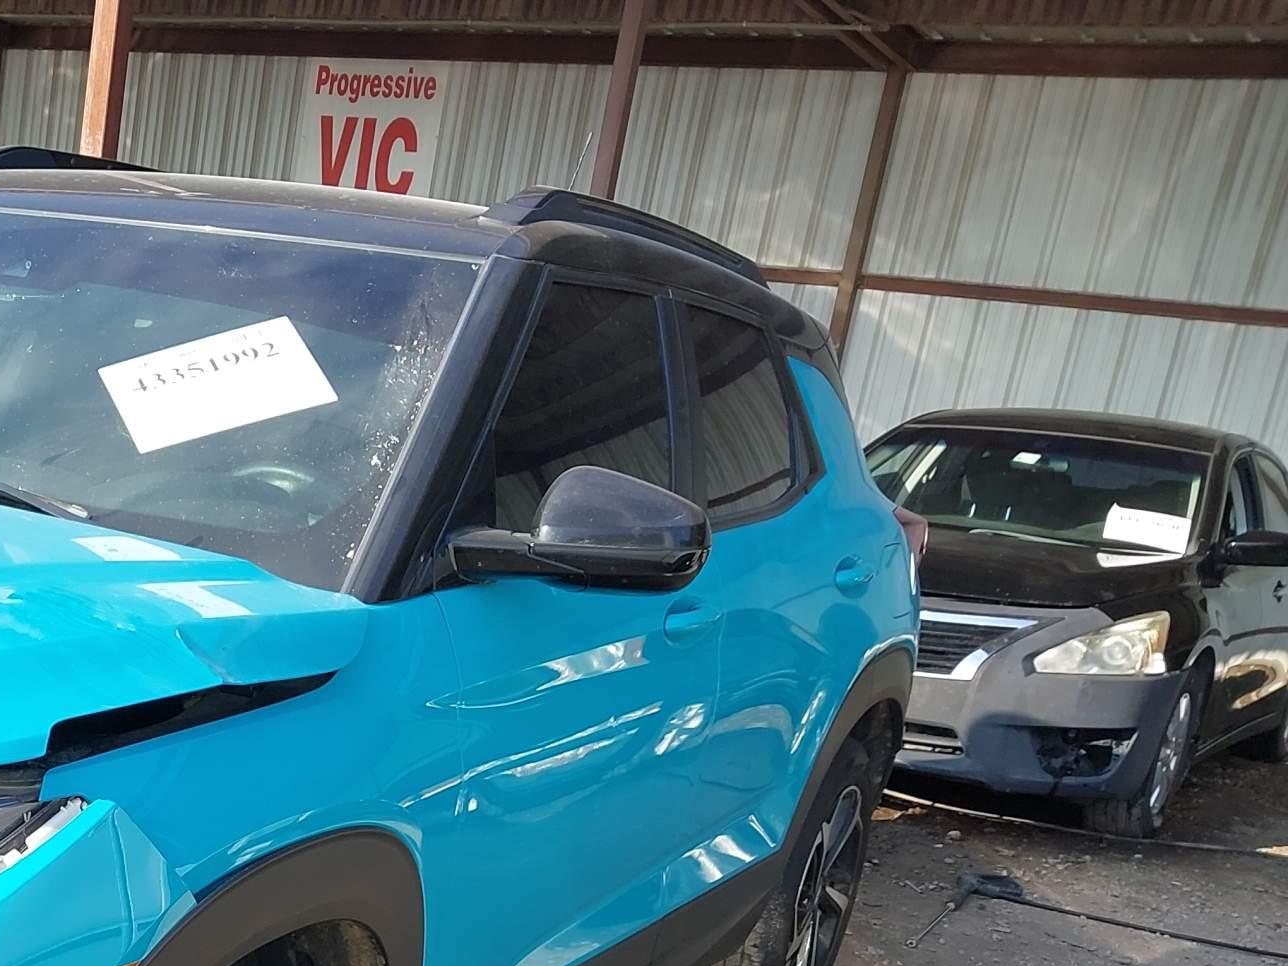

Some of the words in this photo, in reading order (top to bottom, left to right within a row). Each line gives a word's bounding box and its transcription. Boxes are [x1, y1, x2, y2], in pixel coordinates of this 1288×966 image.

[315, 64, 437, 103] Progressive
[320, 115, 418, 195] VIC
[132, 342, 281, 392] 43351992
